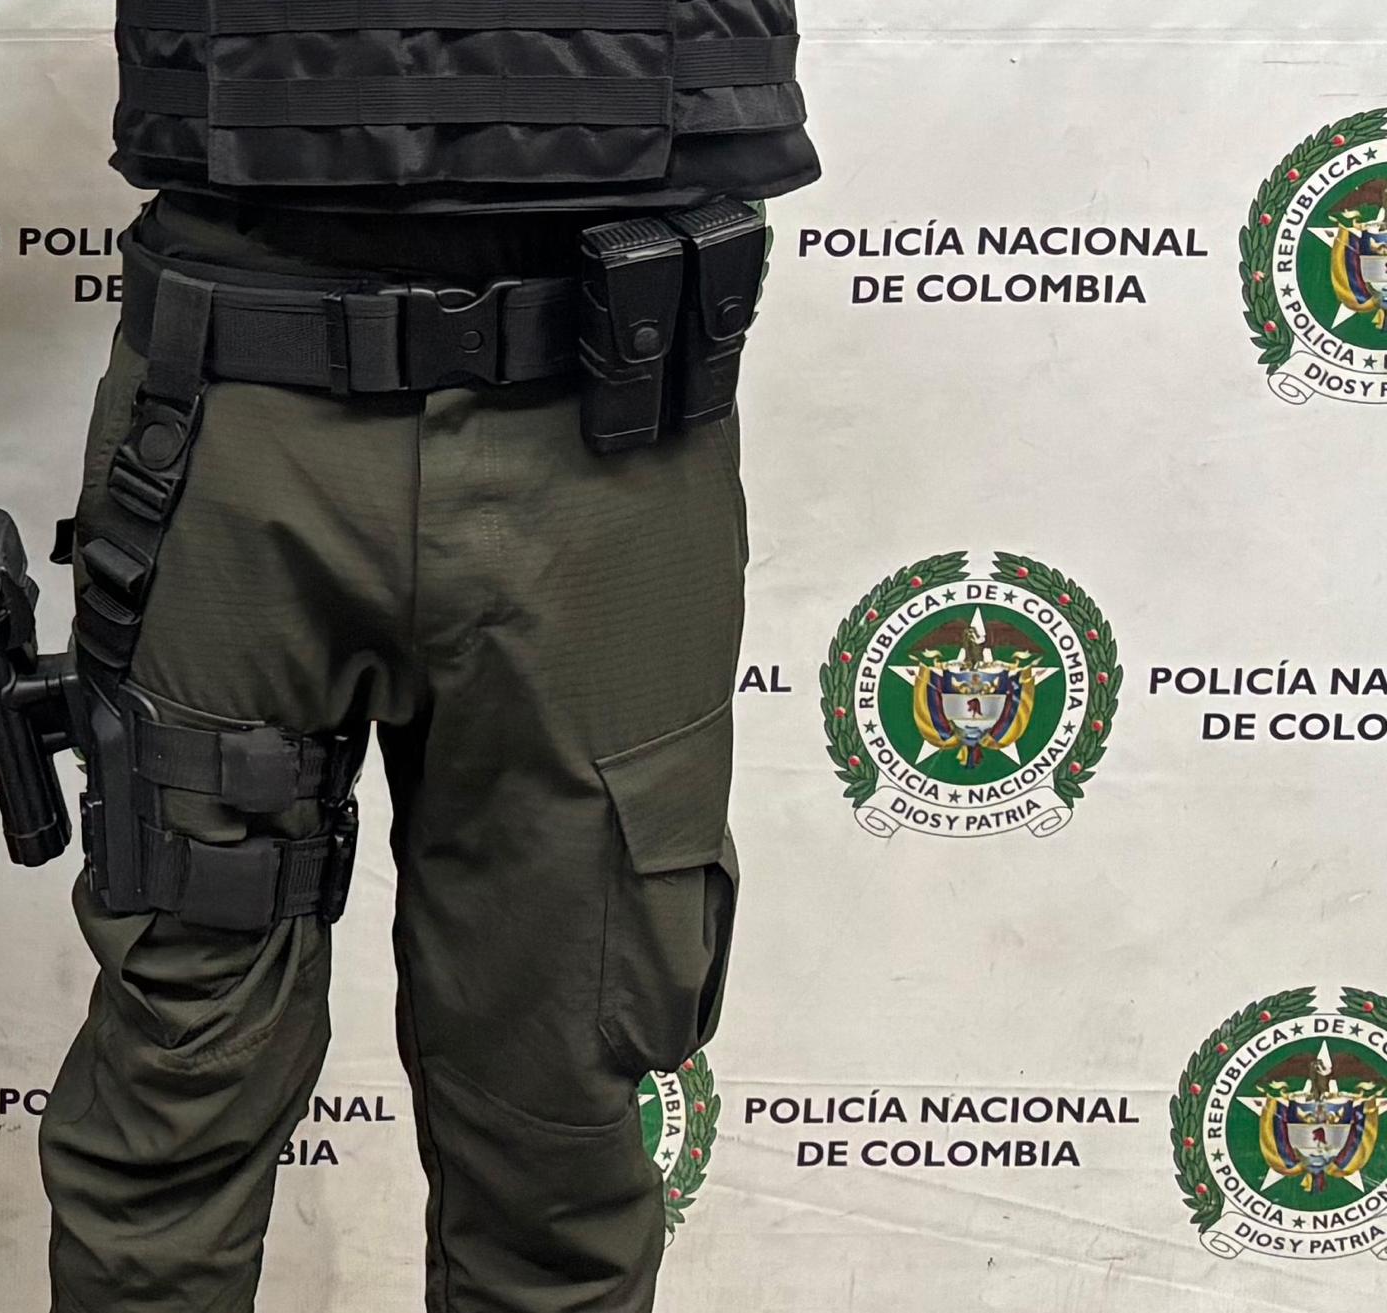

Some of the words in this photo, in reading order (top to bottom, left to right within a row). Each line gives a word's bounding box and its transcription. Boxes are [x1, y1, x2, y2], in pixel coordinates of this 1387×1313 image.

[799, 219, 964, 257] POLICÍA
[978, 227, 1207, 256] NACIONAL
[852, 275, 904, 303] DE
[917, 274, 1146, 303] COLOMBIA
[966, 584, 997, 600] DE
[1021, 597, 1085, 711] COLOMBIA
[1150, 660, 1316, 695] POLICÍA
[1202, 713, 1255, 740] DE
[967, 738, 1072, 803] NACIONAL
[964, 799, 1042, 830] PATRIA
[745, 1088, 907, 1123] POLICÍA
[921, 1097, 1139, 1123] NACIONAL
[797, 1141, 848, 1166] DE
[861, 1141, 1080, 1166] COLOMBIA
